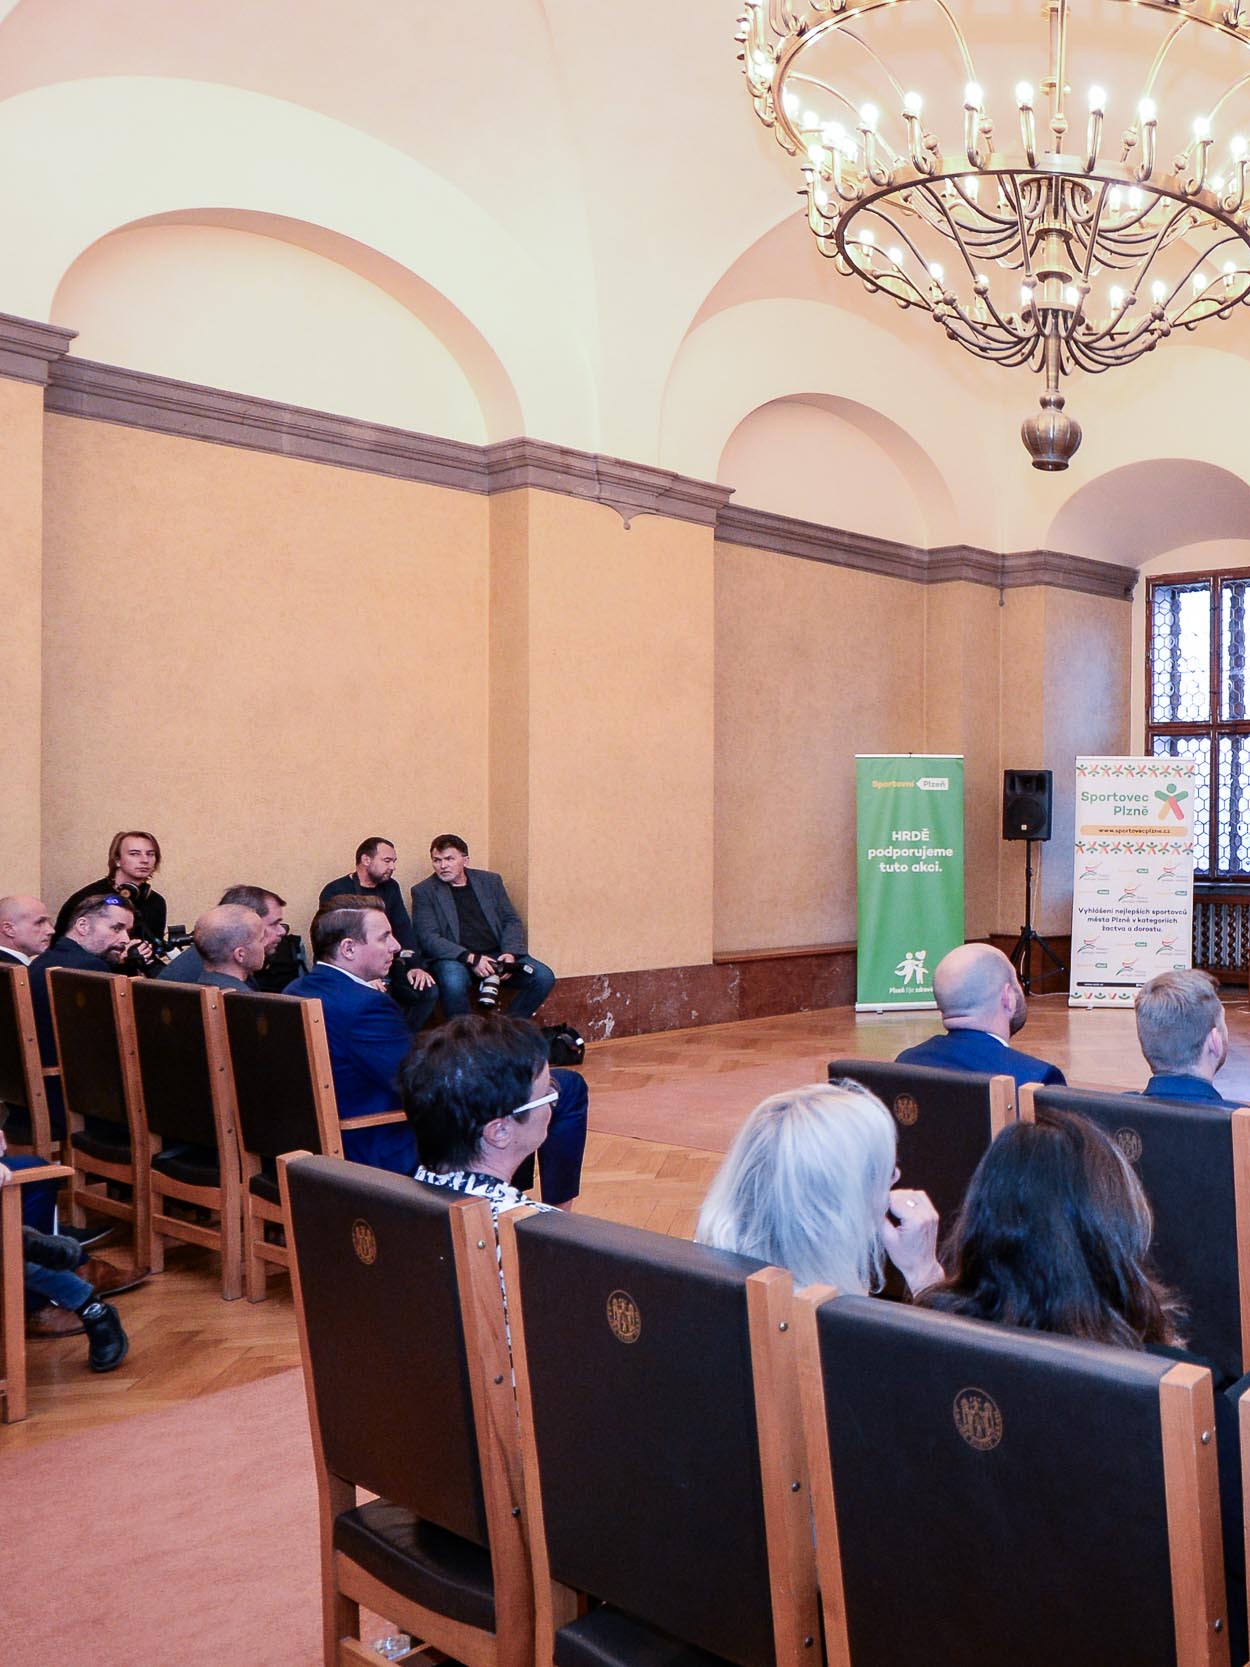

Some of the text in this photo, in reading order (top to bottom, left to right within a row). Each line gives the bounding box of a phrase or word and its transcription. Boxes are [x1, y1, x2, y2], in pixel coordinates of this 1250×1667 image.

[923, 780, 946, 788] Plzeň
[1081, 791, 1149, 804] Sportovec
[1114, 805, 1149, 816] Plzně
[892, 828, 930, 841] HRDĚ
[868, 845, 954, 860] podporujeme
[879, 861, 943, 873] tuto akci.
